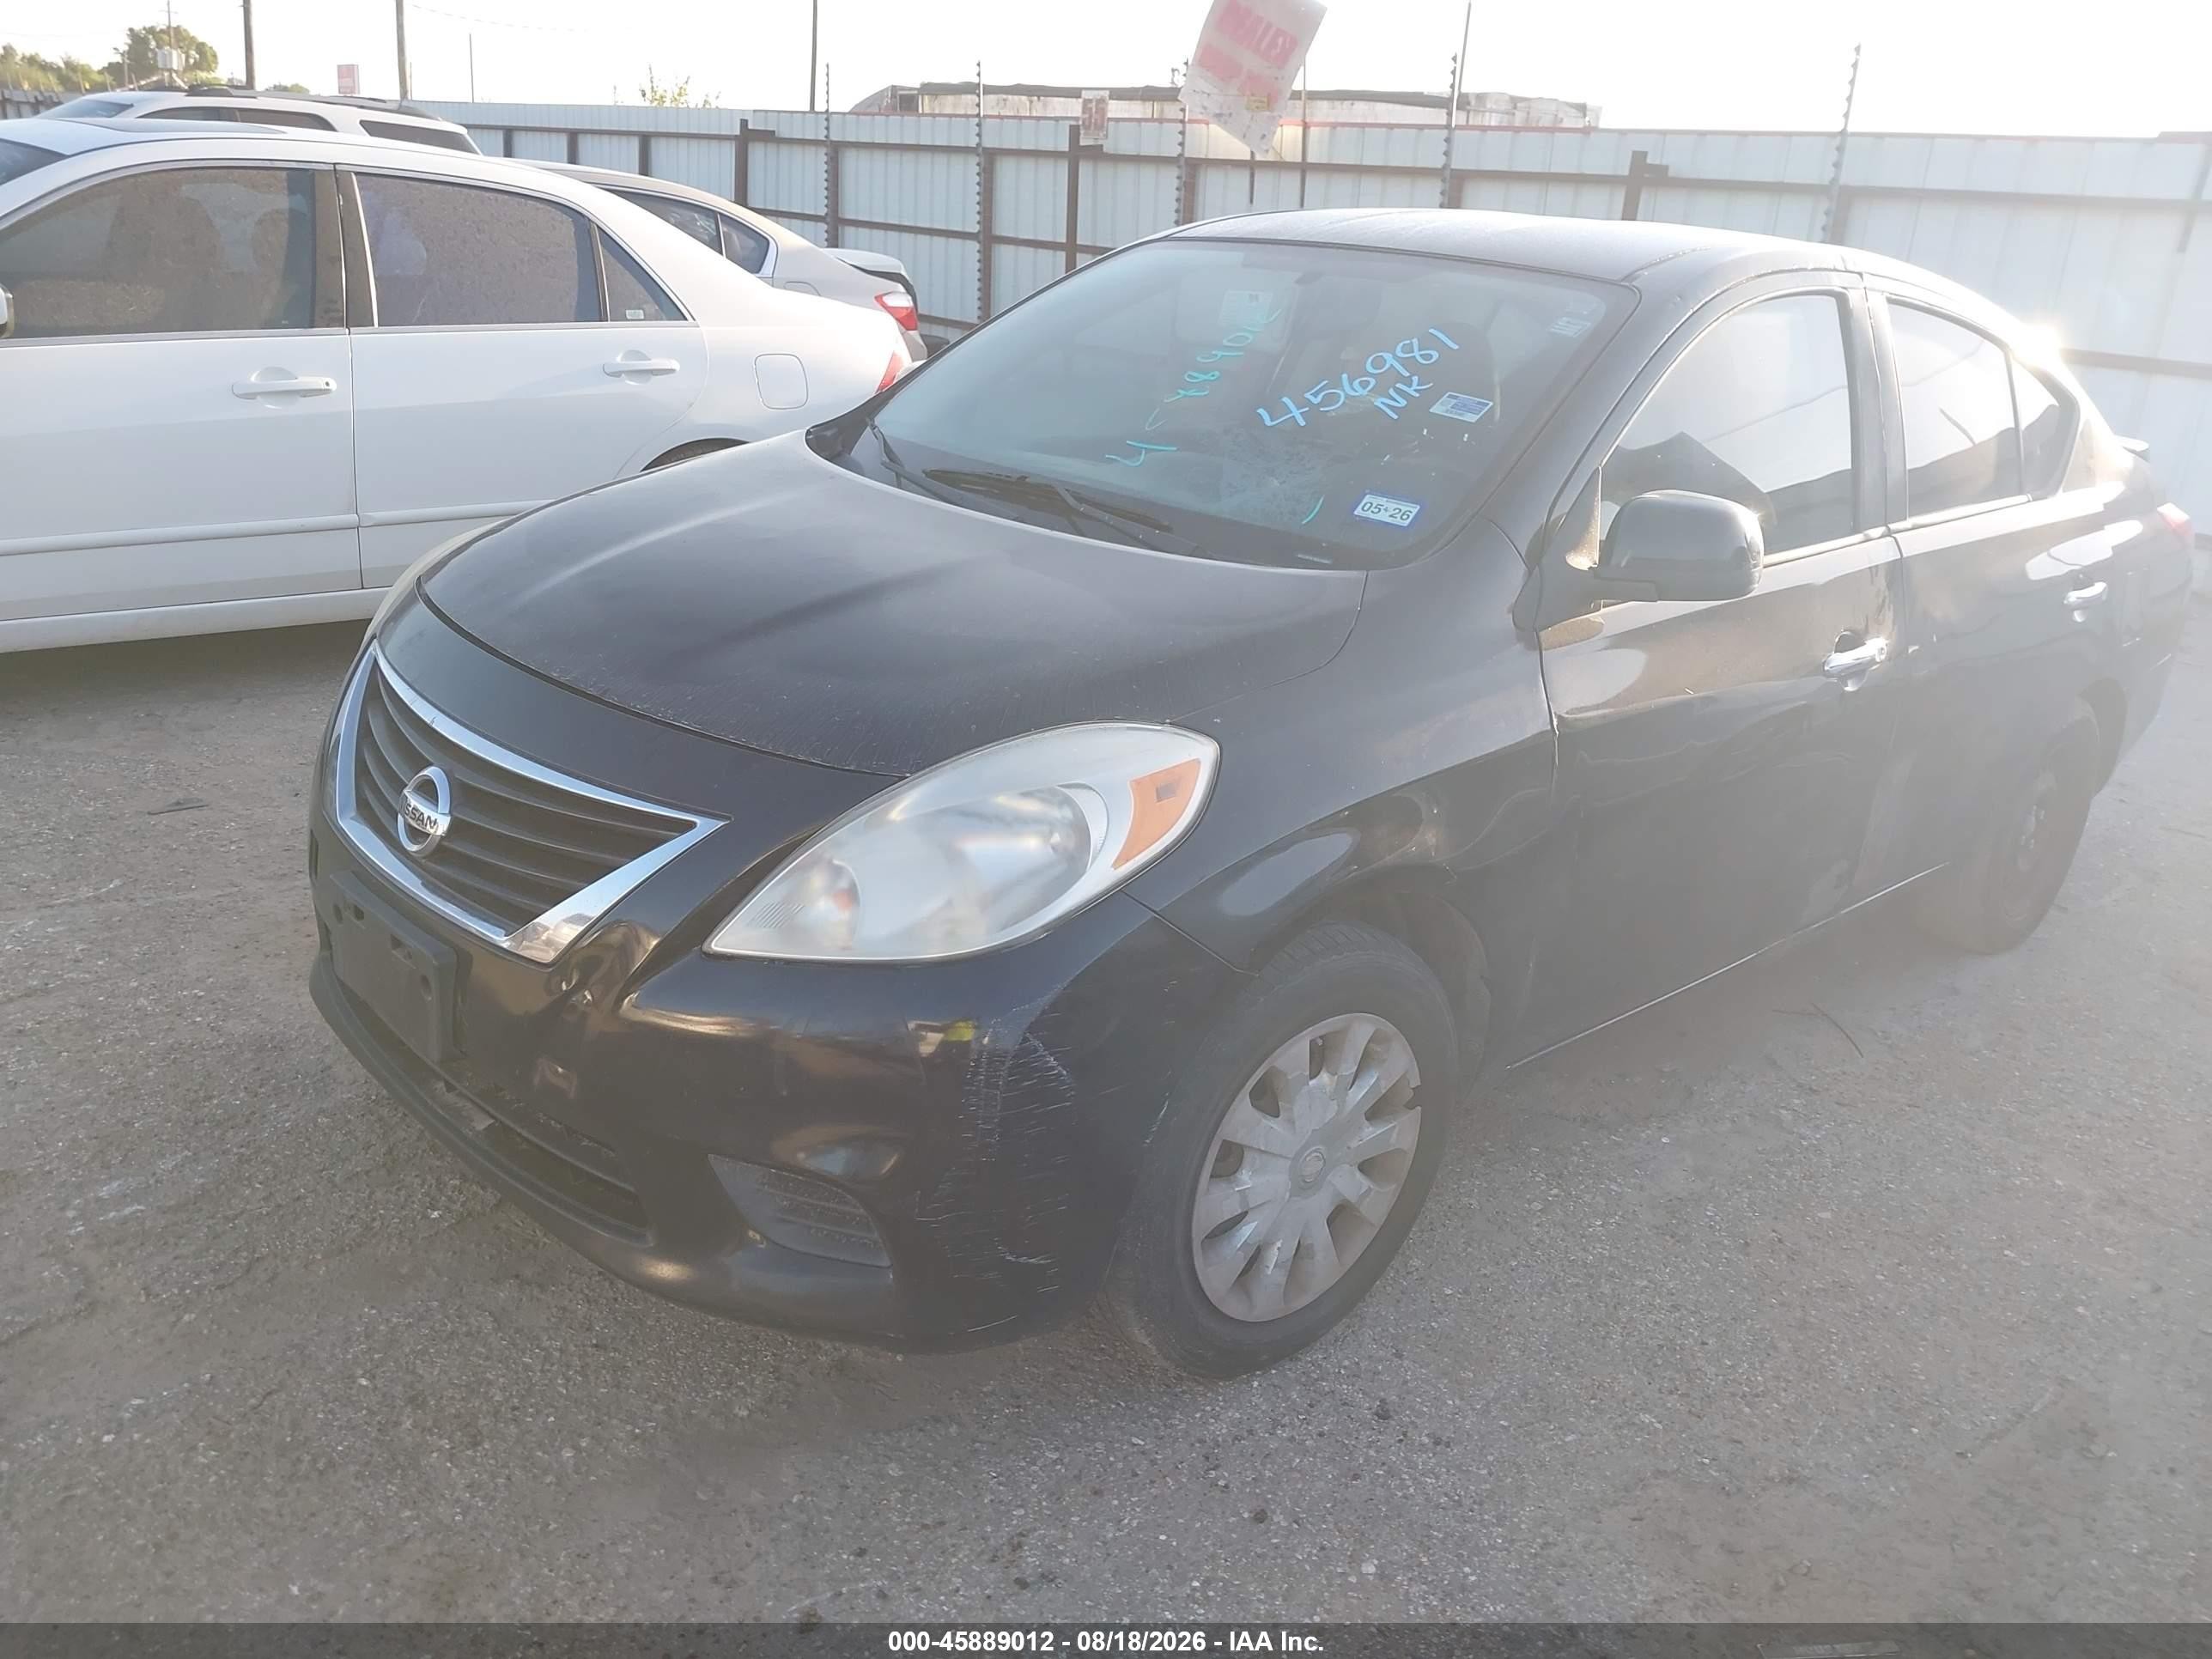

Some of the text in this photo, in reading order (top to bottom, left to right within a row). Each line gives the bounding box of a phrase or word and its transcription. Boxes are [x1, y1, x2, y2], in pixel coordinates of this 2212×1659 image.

[1256, 328, 1459, 427] 456981
[1375, 375, 1433, 419] NK
[1360, 501, 1413, 521] 05 26
[401, 799, 439, 830] SSAN
